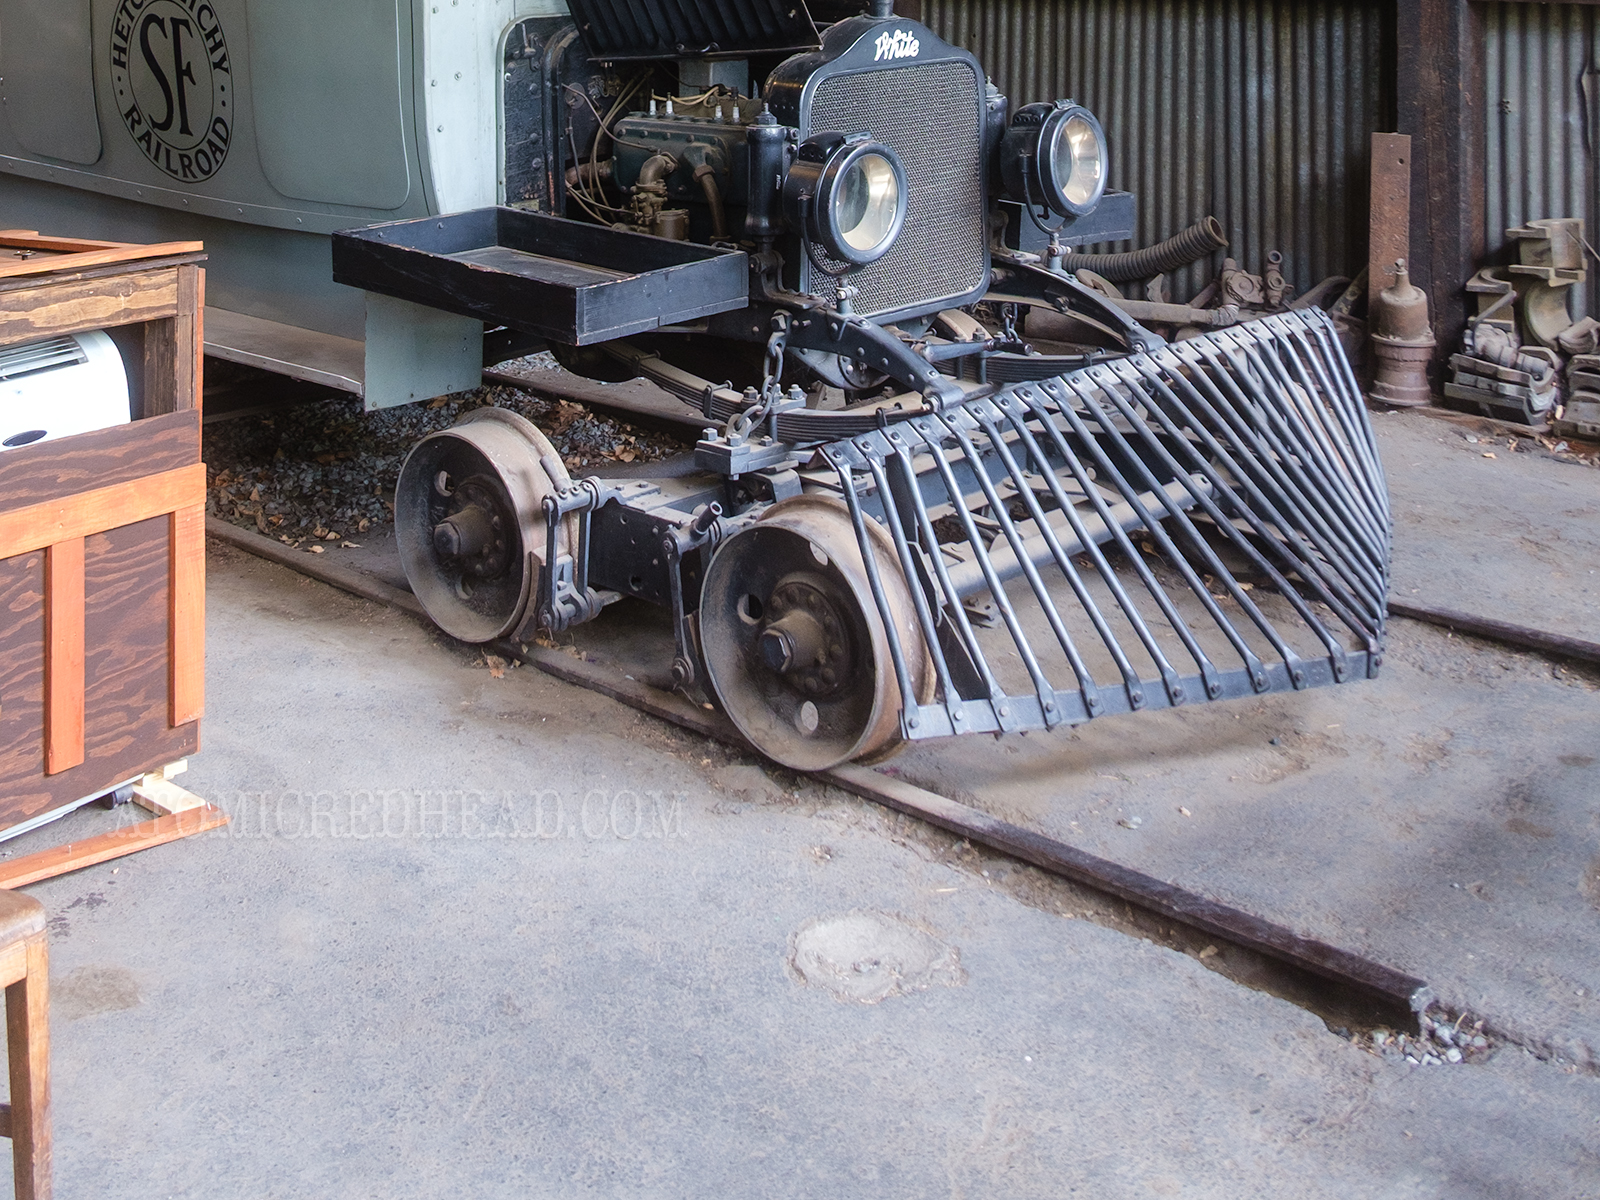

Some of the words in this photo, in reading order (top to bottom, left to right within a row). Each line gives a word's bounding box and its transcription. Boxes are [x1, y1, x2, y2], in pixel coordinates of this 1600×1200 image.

[139, 13, 197, 137] SF
[873, 29, 920, 61] White
[123, 103, 231, 180] RAILROAD
